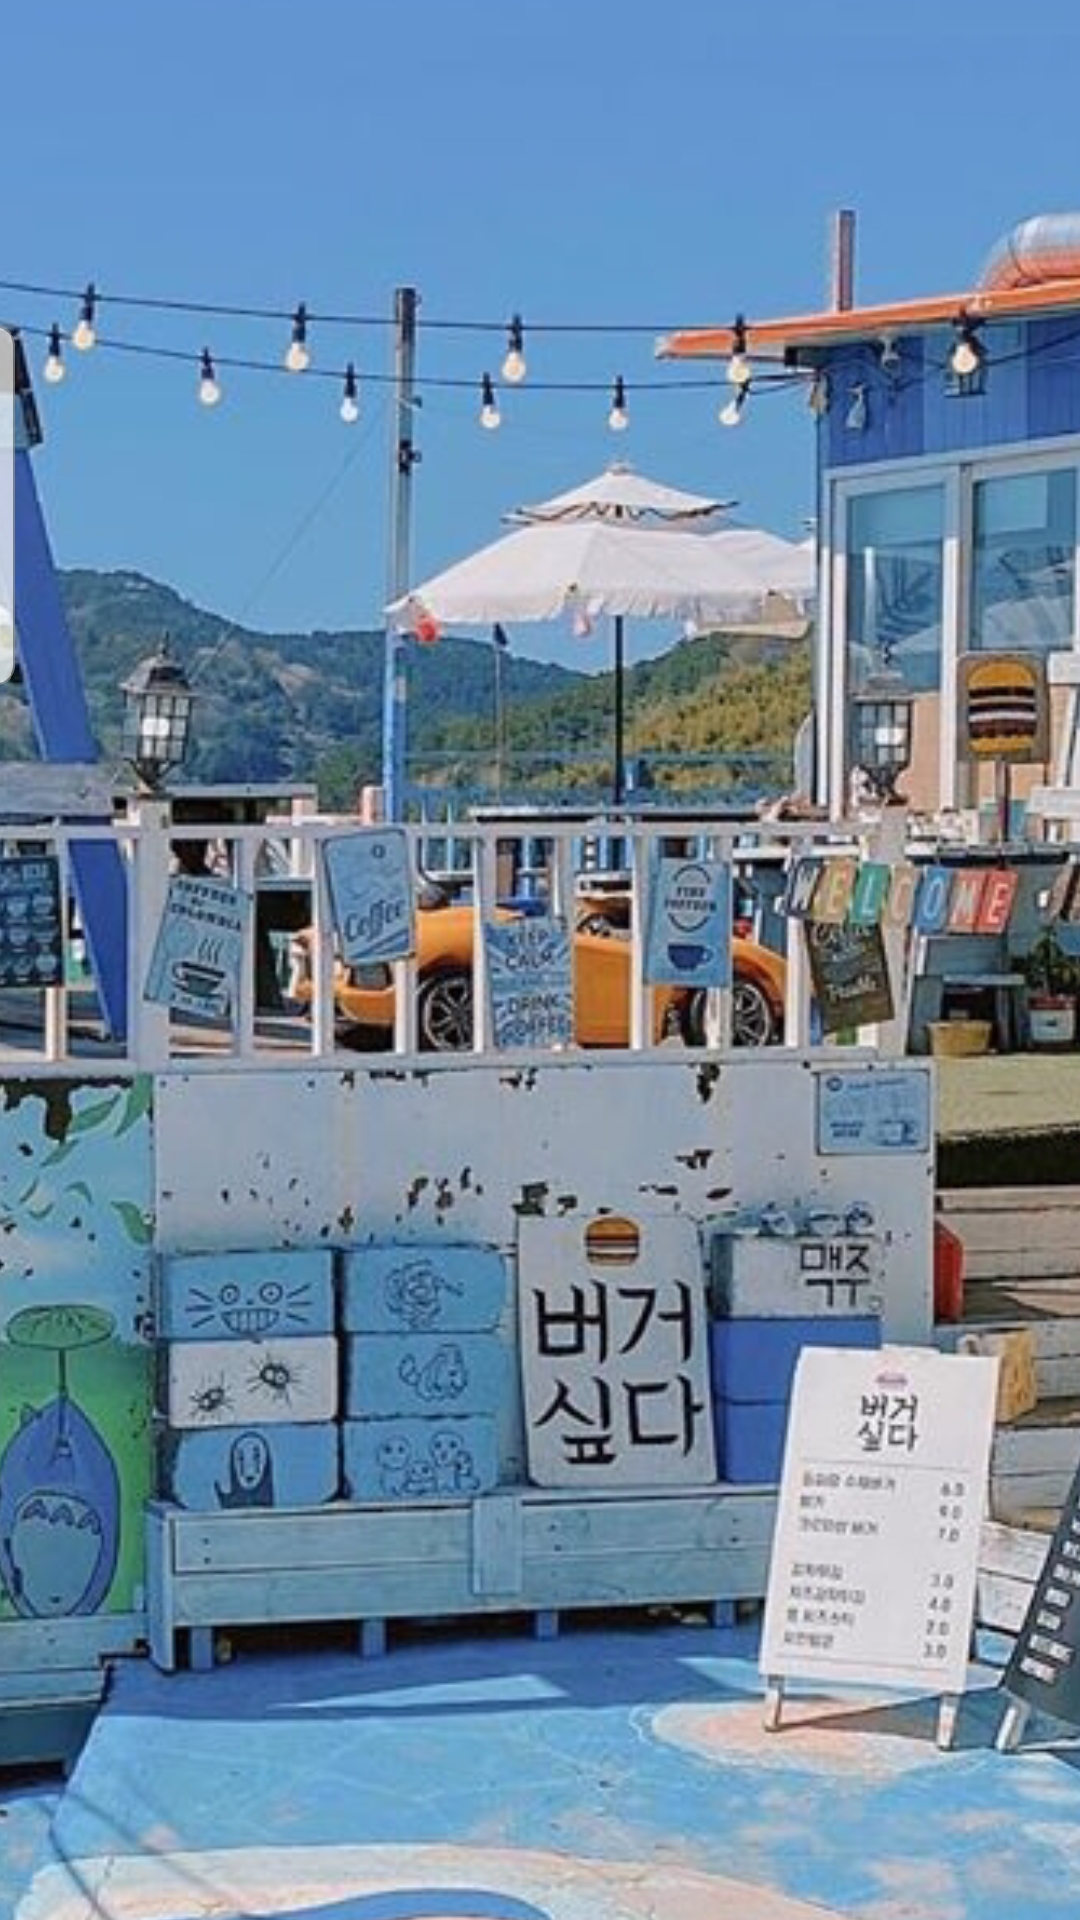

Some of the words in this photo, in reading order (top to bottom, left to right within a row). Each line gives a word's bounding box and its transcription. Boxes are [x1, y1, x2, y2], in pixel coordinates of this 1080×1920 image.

[345, 899, 406, 942] Coffee
[789, 861, 1011, 926] WELCOME
[800, 1243, 871, 1308] 맥주
[532, 1278, 693, 1365] 버거
[533, 1373, 705, 1465] 싶다
[857, 1420, 919, 1452] 싶다
[860, 1394, 918, 1423] 버거
